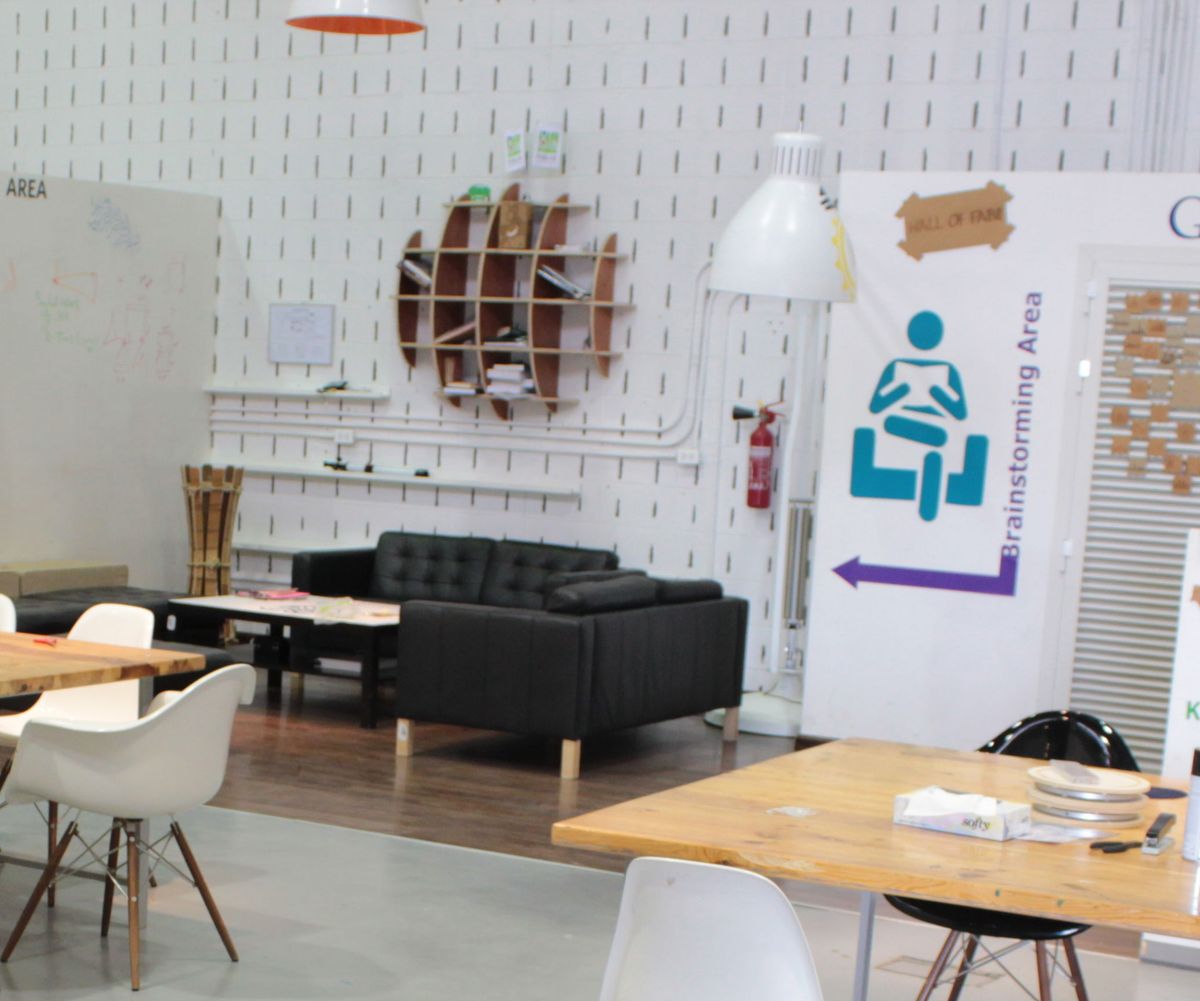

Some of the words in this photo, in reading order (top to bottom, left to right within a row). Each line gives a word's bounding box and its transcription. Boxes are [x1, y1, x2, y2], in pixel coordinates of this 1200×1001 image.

[6, 177, 48, 201] AREA
[1017, 291, 1043, 355] Area
[1001, 363, 1041, 559] Brainstorming
[961, 815, 991, 832] softy
